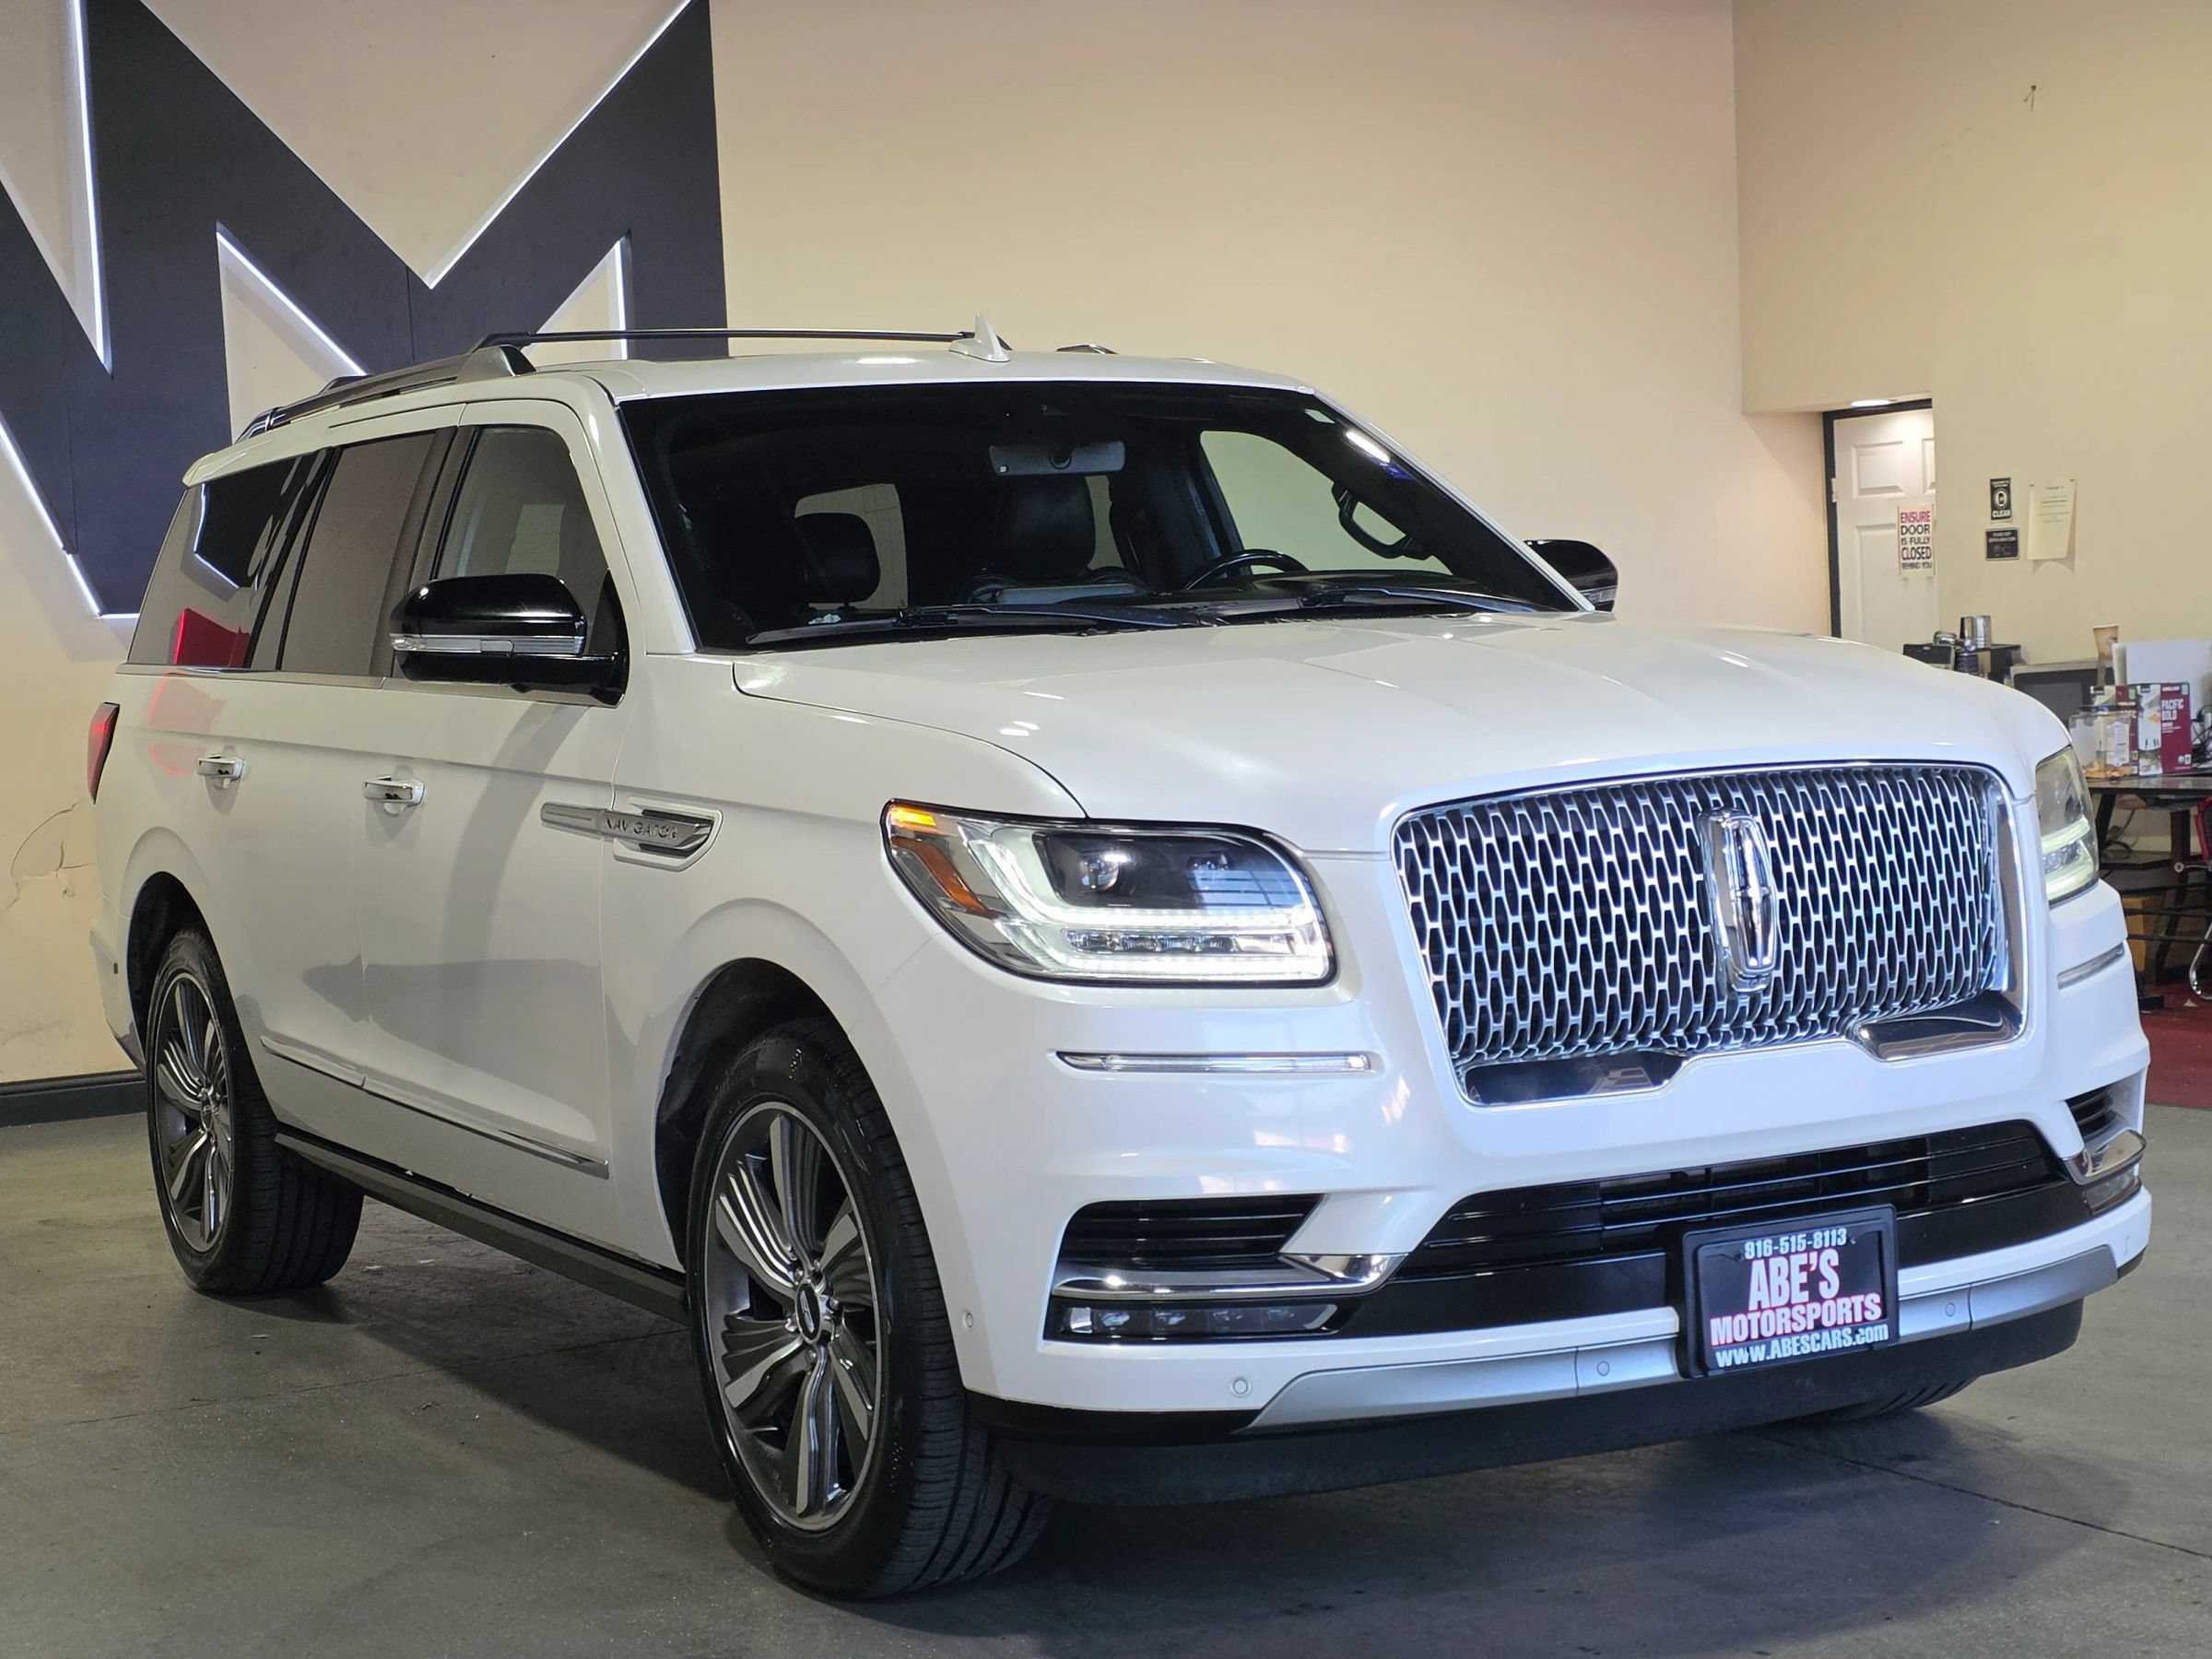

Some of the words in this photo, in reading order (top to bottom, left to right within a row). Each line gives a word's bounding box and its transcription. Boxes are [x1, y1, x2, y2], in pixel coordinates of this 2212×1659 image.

[1900, 511, 1931, 524] ENSURE
[1900, 524, 1930, 535] DOOR
[1901, 537, 1907, 546] IS
[1910, 536, 1930, 545] FULLY
[1901, 547, 1932, 560] CLOSED
[606, 818, 678, 840] NAVGATOR
[1745, 1228, 1847, 1260] 916-515-8113
[1748, 1248, 1840, 1312] ABE'S
[1710, 1292, 1882, 1347] MOTORSPORTS
